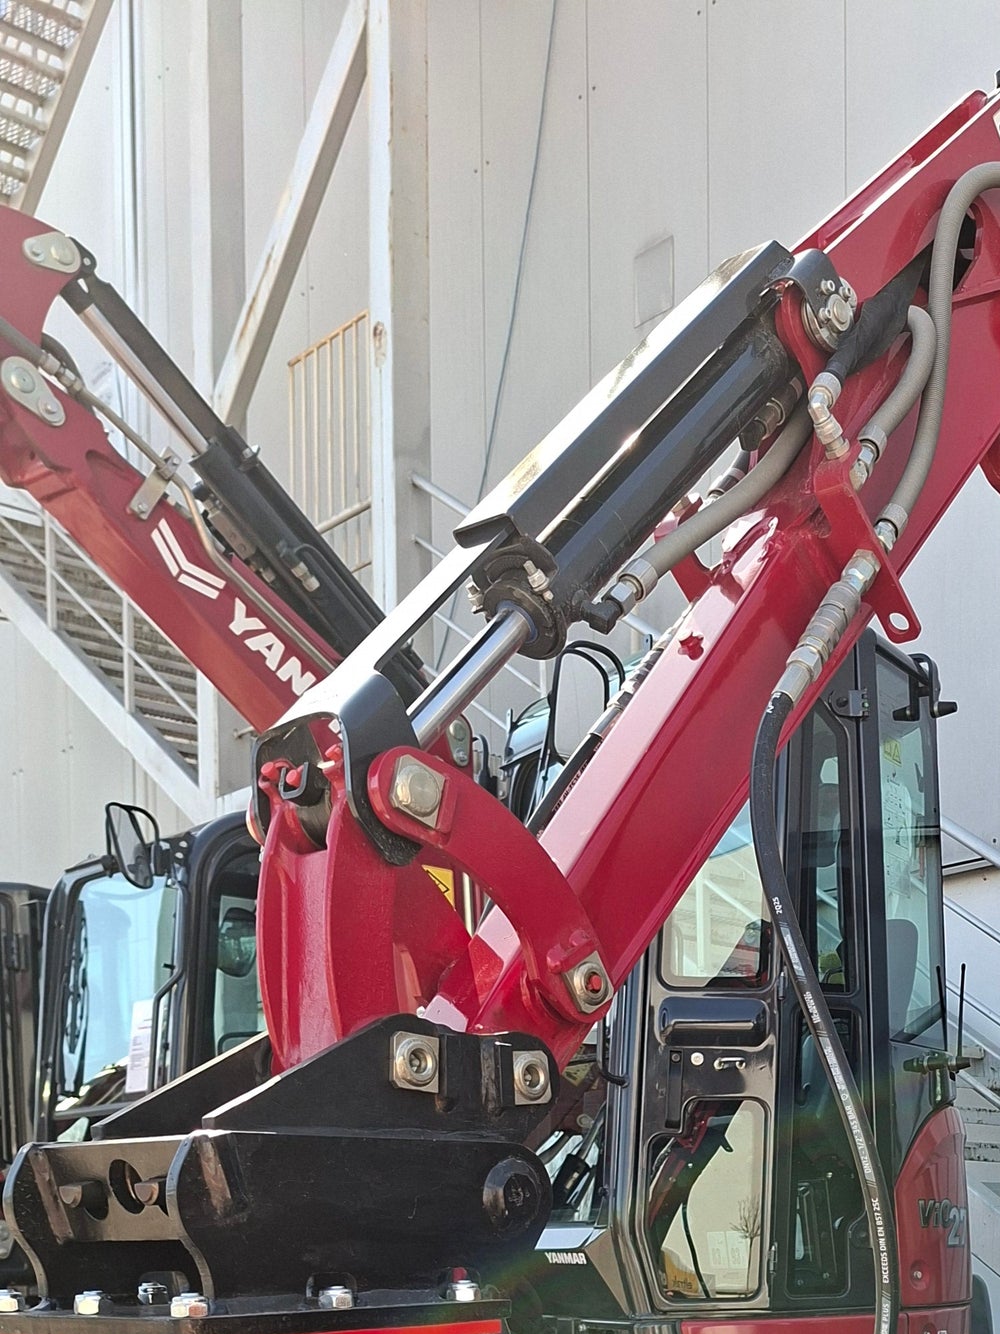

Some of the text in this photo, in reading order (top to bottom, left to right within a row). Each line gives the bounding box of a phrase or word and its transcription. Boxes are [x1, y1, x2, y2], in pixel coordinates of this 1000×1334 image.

[229, 597, 317, 697] YAN
[544, 1252, 587, 1265] YANMAR
[871, 1197, 890, 1283] EXCEEDS DIN EN 857 2SC
